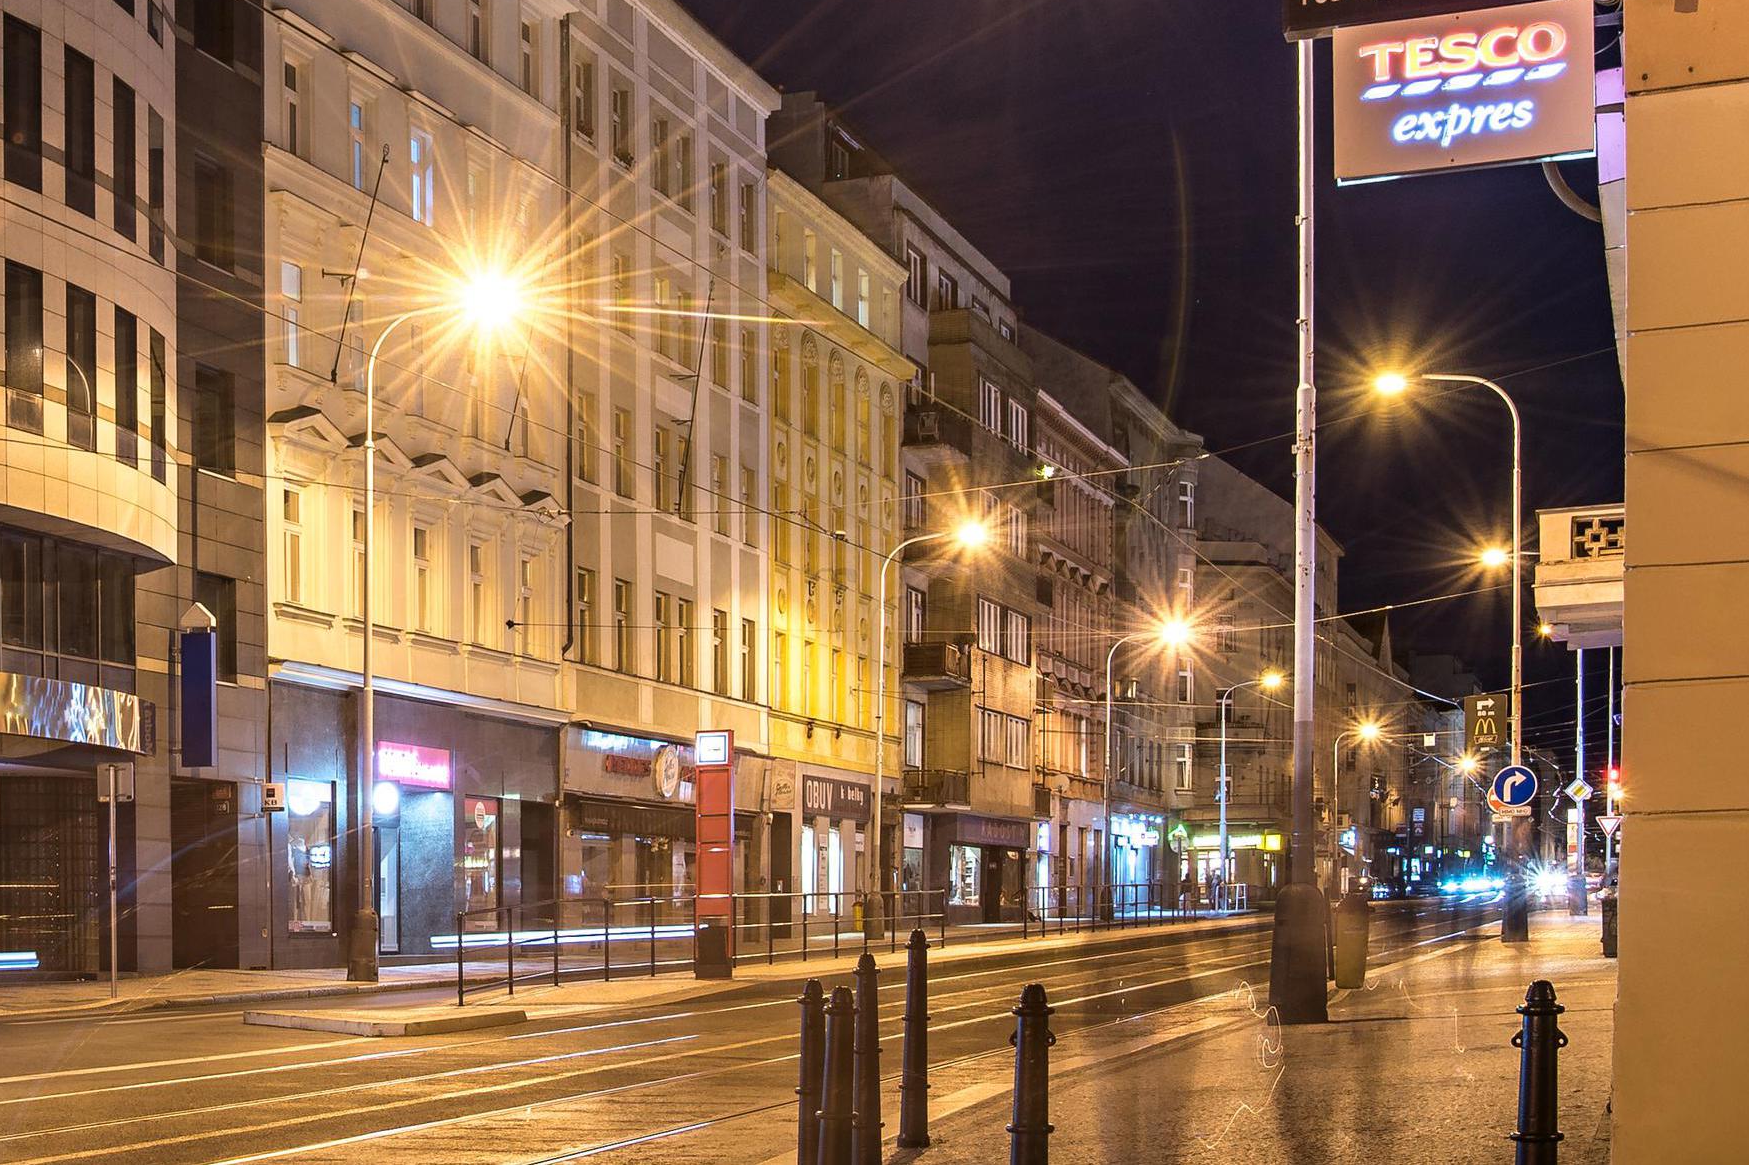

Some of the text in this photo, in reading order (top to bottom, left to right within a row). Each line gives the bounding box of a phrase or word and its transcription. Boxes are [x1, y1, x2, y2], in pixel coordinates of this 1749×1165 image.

[1358, 20, 1567, 82] TESCO
[1393, 98, 1534, 147] expres
[807, 780, 833, 810] OBUV
